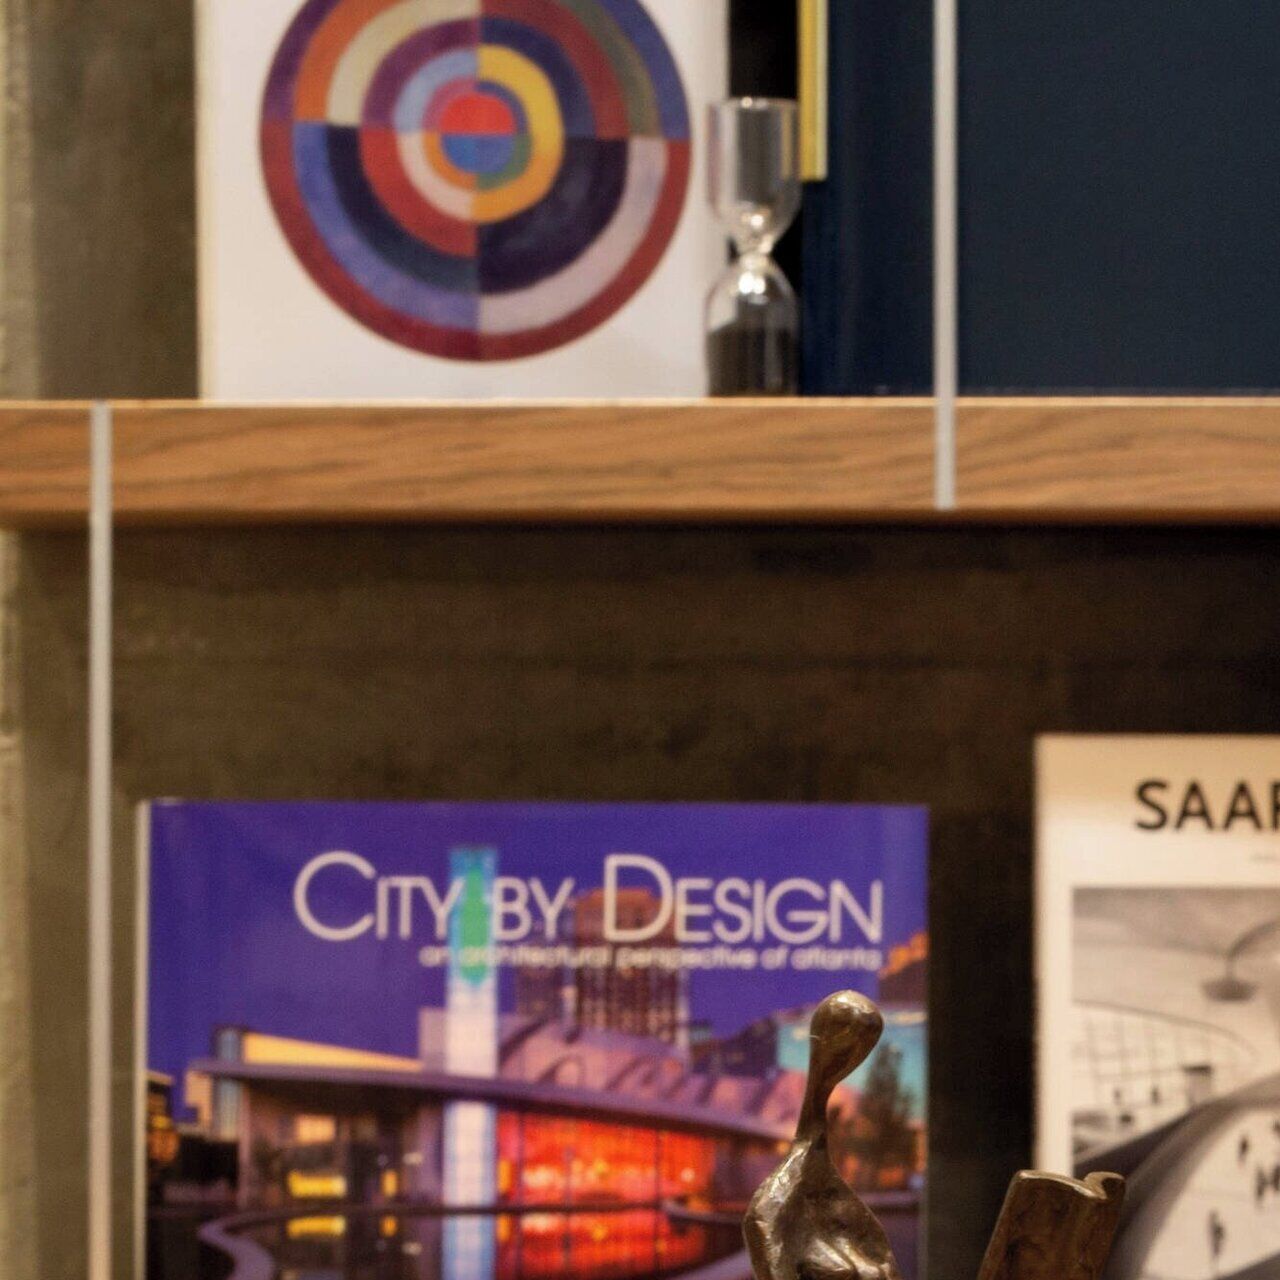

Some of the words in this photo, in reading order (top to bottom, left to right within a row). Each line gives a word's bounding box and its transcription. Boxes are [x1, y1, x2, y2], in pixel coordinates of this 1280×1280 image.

[492, 876, 576, 942] BY
[603, 853, 884, 944] DESIGN
[616, 944, 756, 972] perspective
[760, 944, 788, 970] of
[791, 945, 884, 971] atlanta
